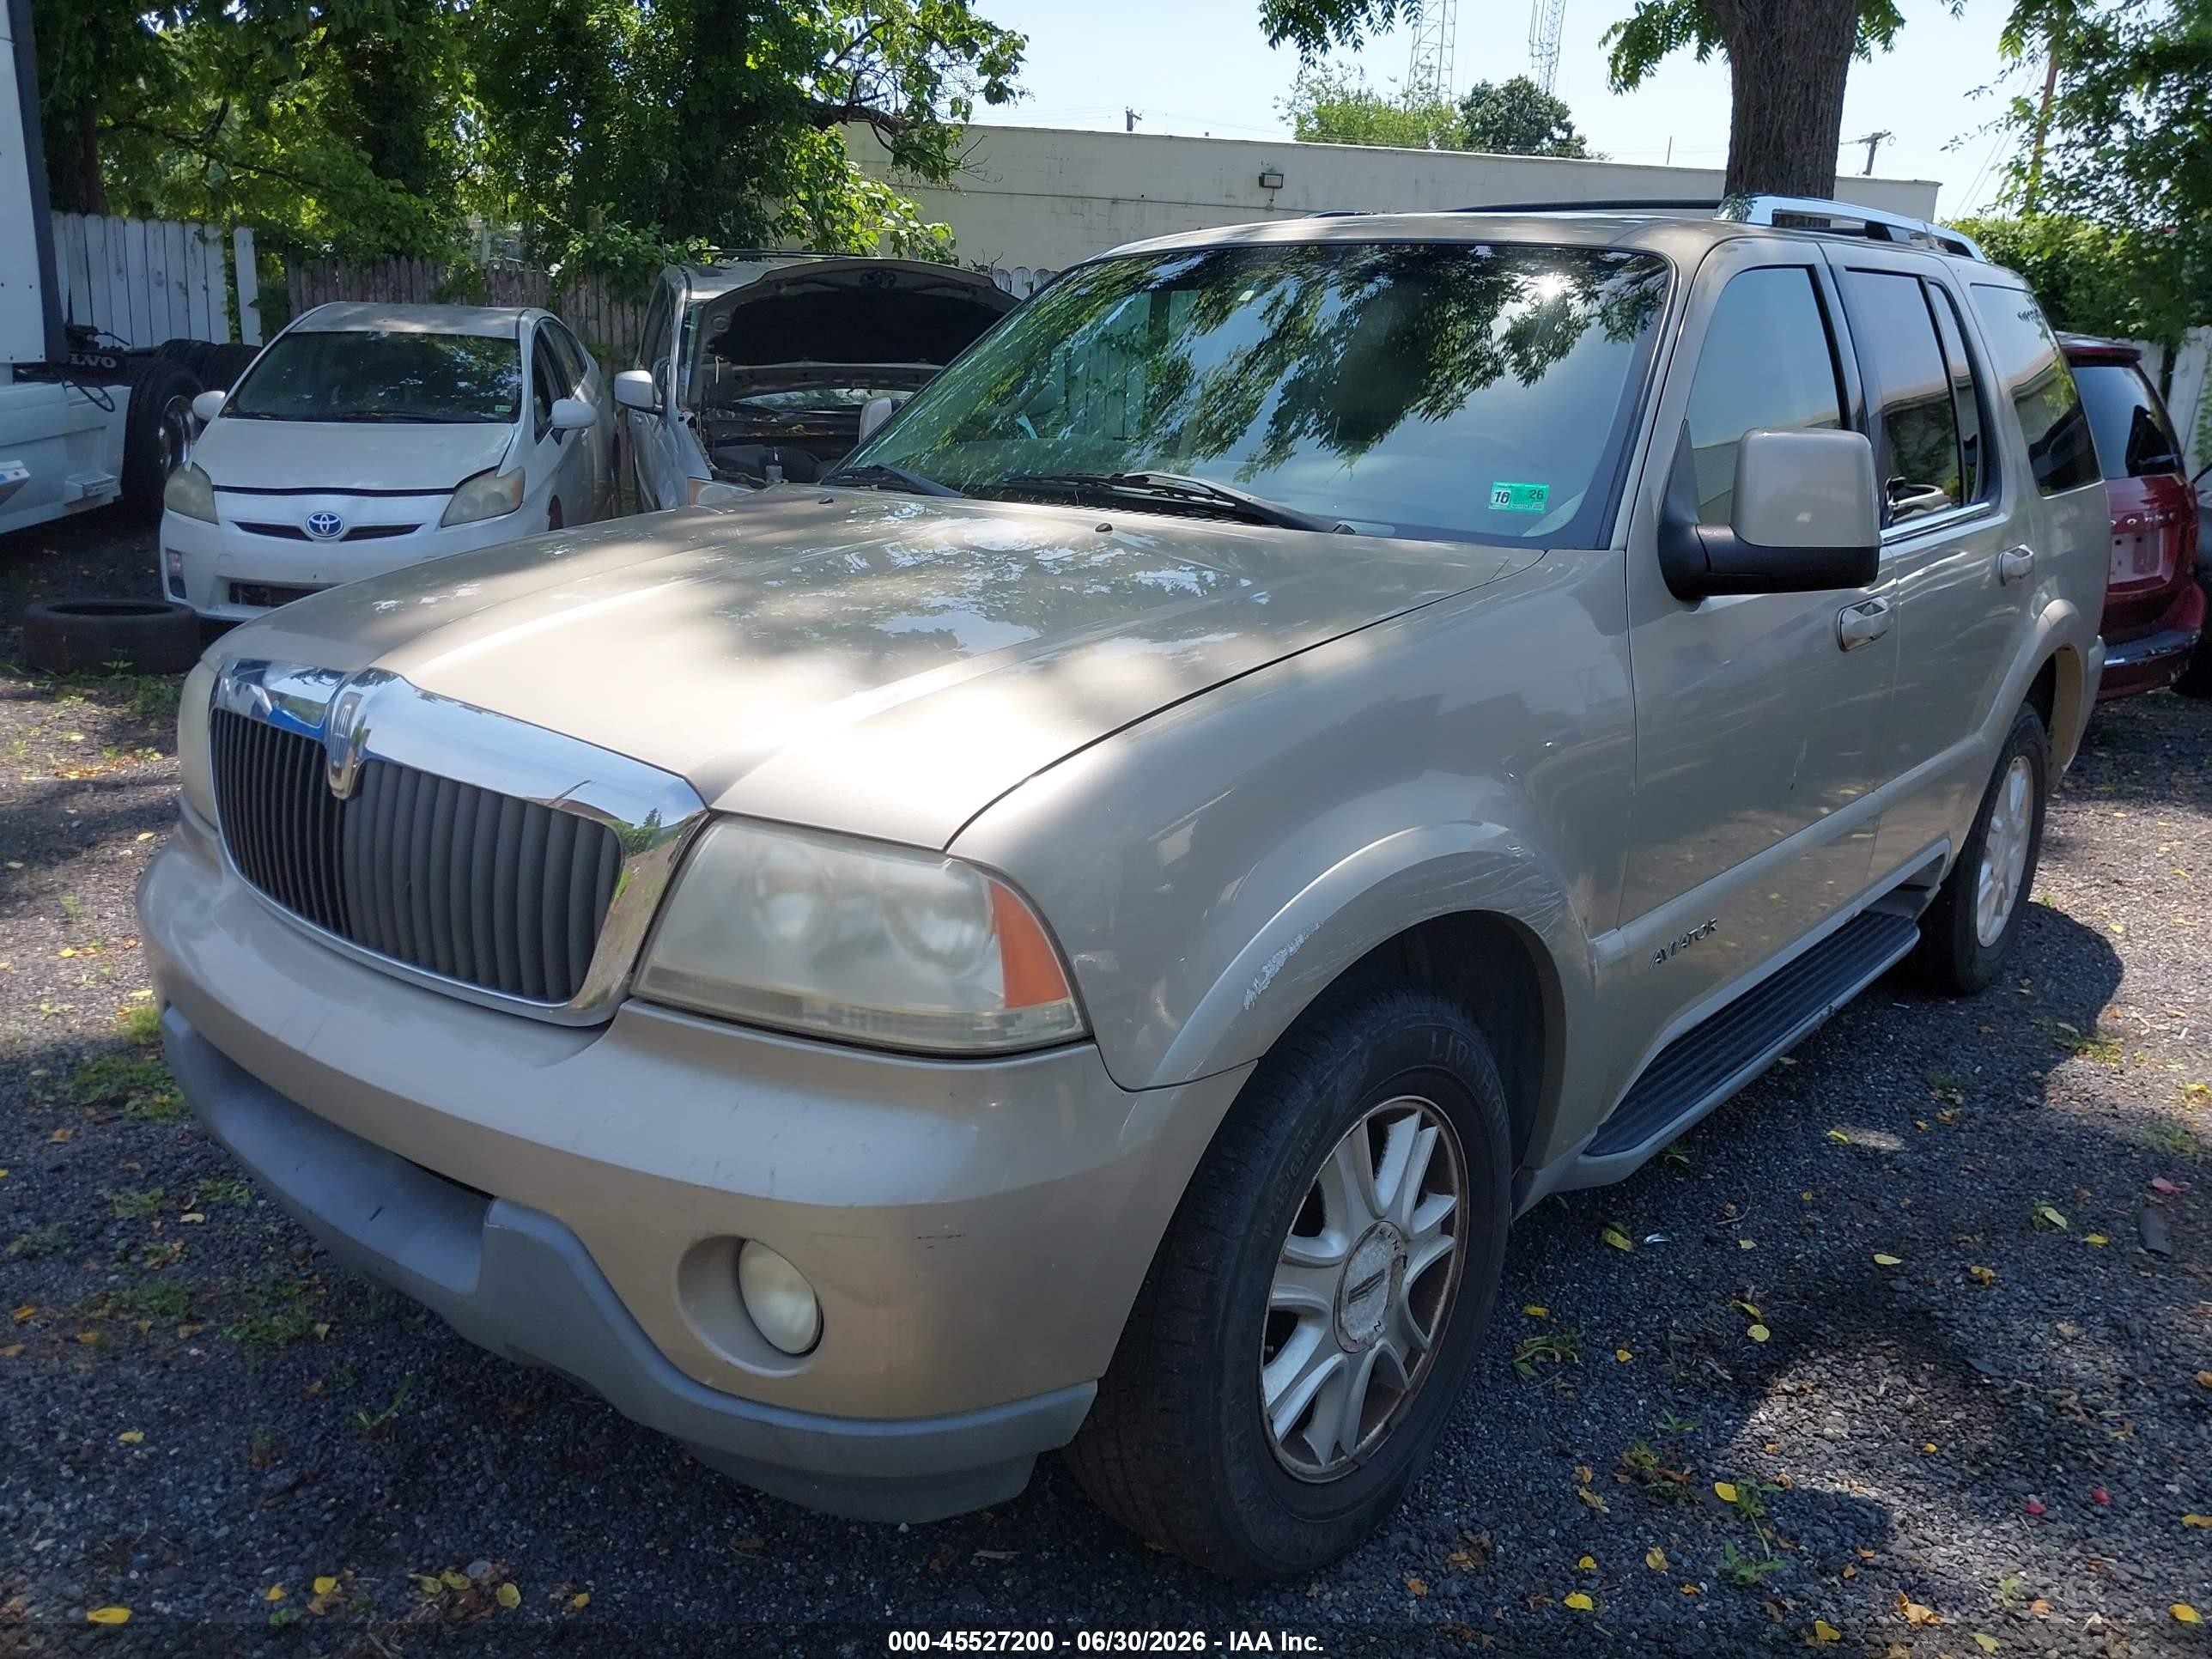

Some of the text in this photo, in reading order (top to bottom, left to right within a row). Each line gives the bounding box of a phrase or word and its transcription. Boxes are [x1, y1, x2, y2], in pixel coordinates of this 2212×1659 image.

[70, 353, 117, 368] LVO
[1529, 489, 1544, 500] 26
[1649, 917, 1717, 969] AVIATOR
